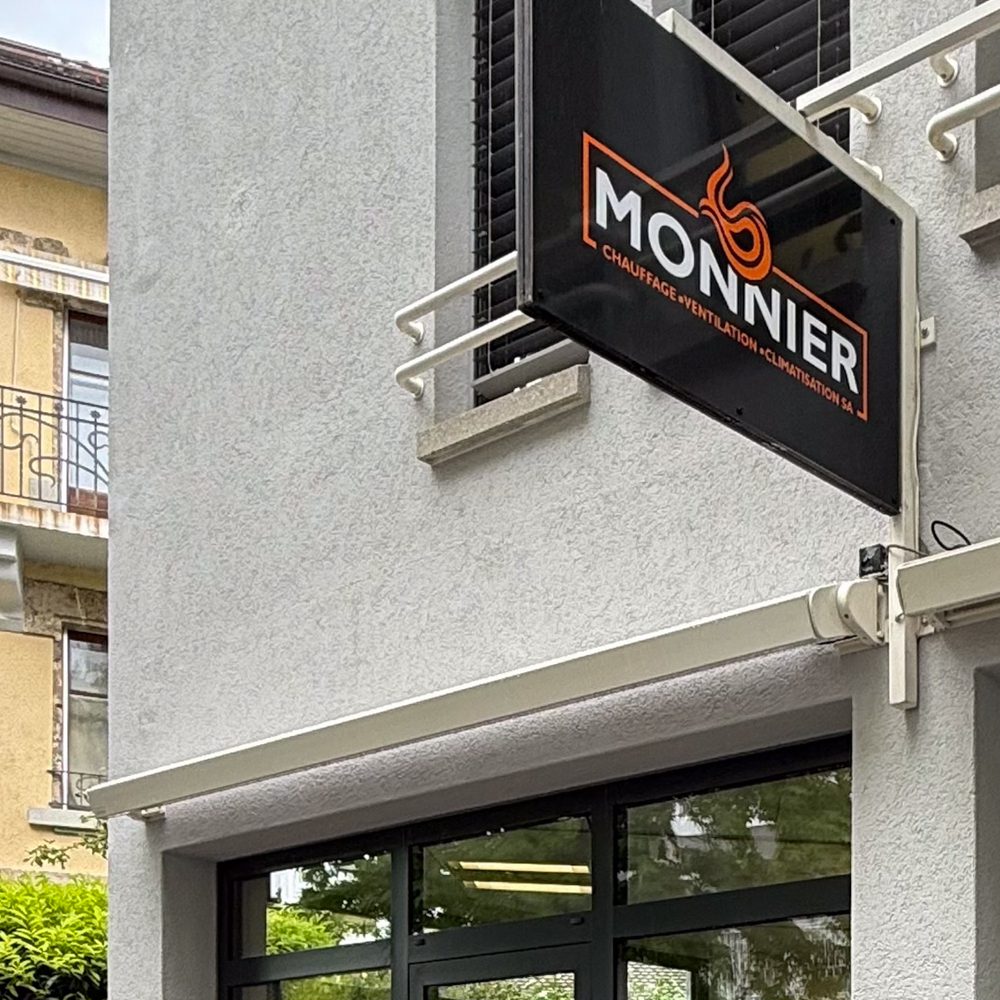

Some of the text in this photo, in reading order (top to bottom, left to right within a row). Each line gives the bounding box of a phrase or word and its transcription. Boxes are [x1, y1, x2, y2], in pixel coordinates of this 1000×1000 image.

[595, 166, 859, 395] MONNIER
[602, 244, 854, 415] CHAUFFAGE VENTILATION CLIMATISATION SA
